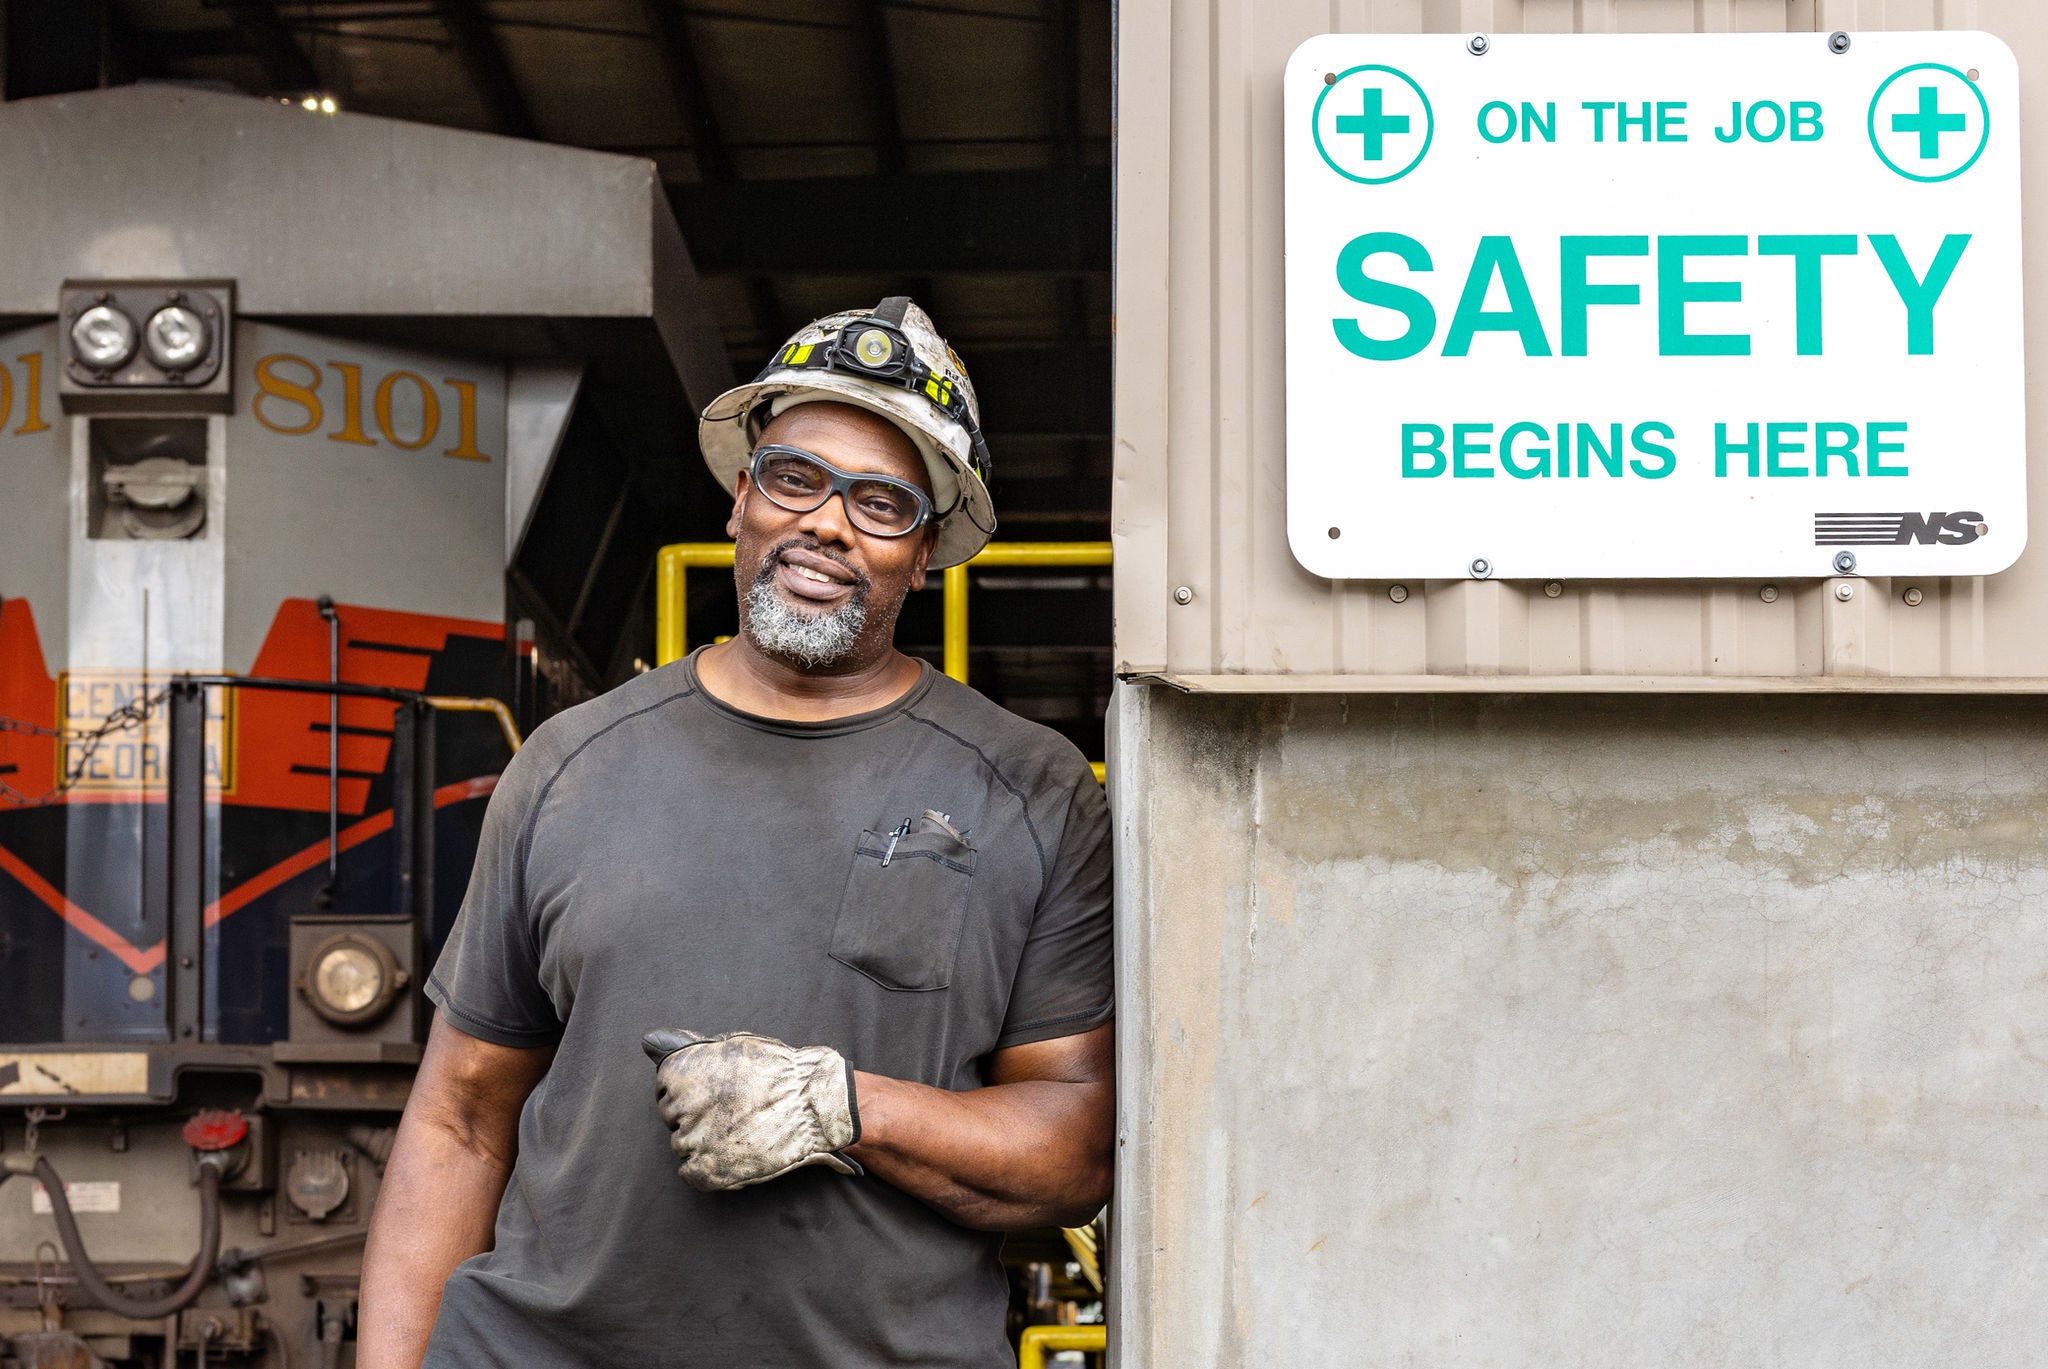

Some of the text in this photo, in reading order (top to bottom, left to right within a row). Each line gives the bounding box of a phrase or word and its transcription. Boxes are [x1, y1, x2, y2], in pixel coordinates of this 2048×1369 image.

[1477, 99, 1824, 144] ON THE JOB
[1331, 231, 1973, 362] SAFETY
[0, 351, 52, 435] 1
[252, 353, 493, 463] 8101
[1401, 421, 1909, 480] BEGINS HERE
[1895, 511, 1984, 546] NS
[65, 681, 224, 720] CENTL
[65, 743, 222, 781] GEORA
